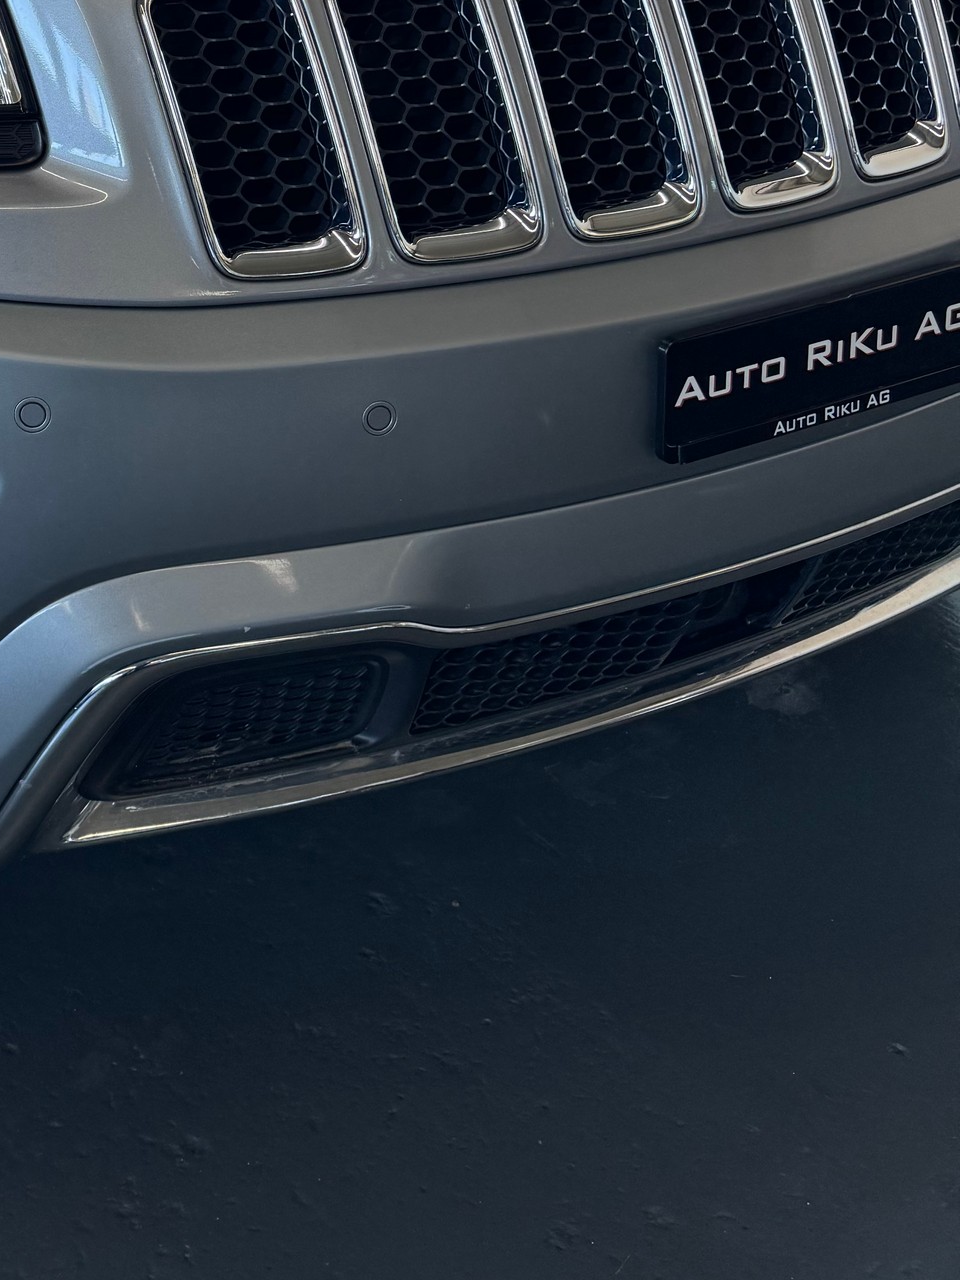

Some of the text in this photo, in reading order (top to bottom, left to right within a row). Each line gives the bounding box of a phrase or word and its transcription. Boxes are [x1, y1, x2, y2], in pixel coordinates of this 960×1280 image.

[674, 356, 786, 408] AUTO
[773, 412, 817, 436] AUTO
[866, 389, 890, 409] AG
